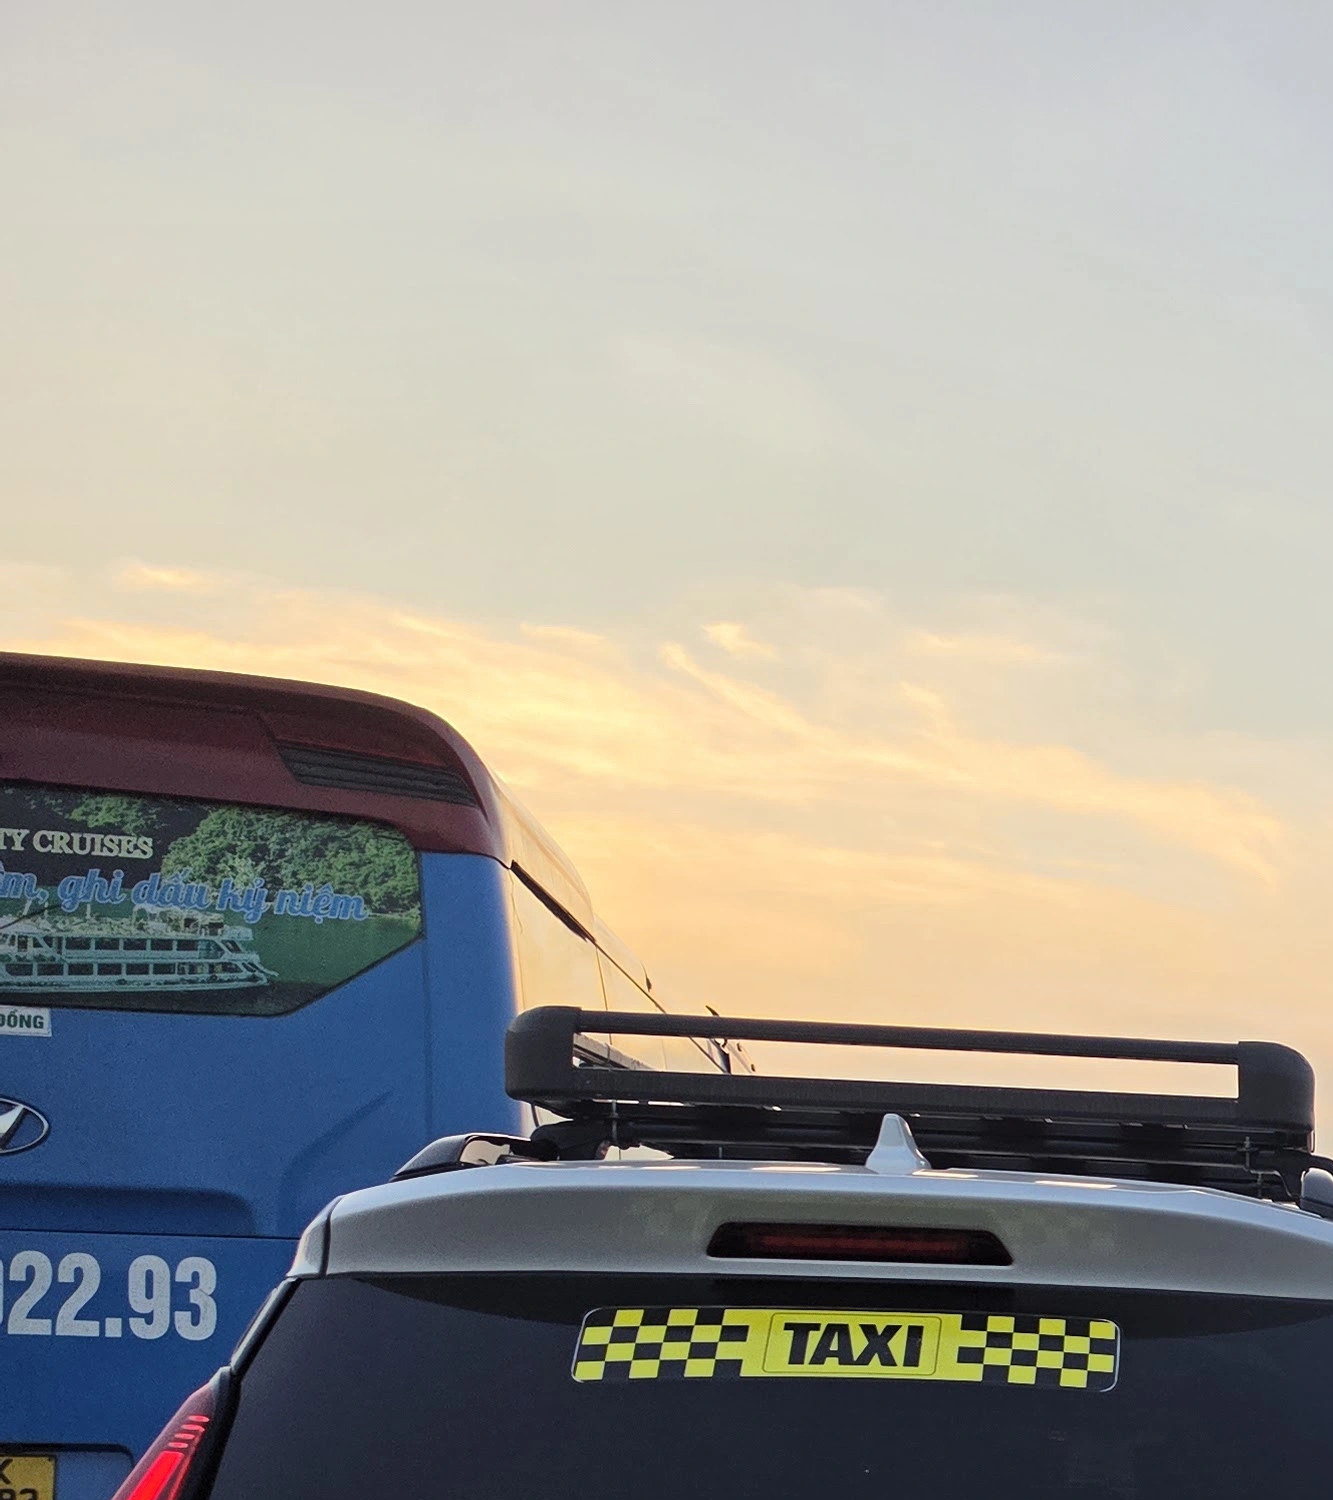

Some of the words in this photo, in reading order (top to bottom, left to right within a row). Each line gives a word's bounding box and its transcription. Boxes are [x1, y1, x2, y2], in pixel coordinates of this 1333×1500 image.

[32, 830, 153, 859] CRUISES
[57, 868, 126, 913] ghi
[131, 867, 212, 909] dấu
[215, 877, 274, 924] kỷ
[273, 882, 372, 924] niệm
[0, 1250, 217, 1340] 22.93
[784, 1322, 924, 1367] TAXI
